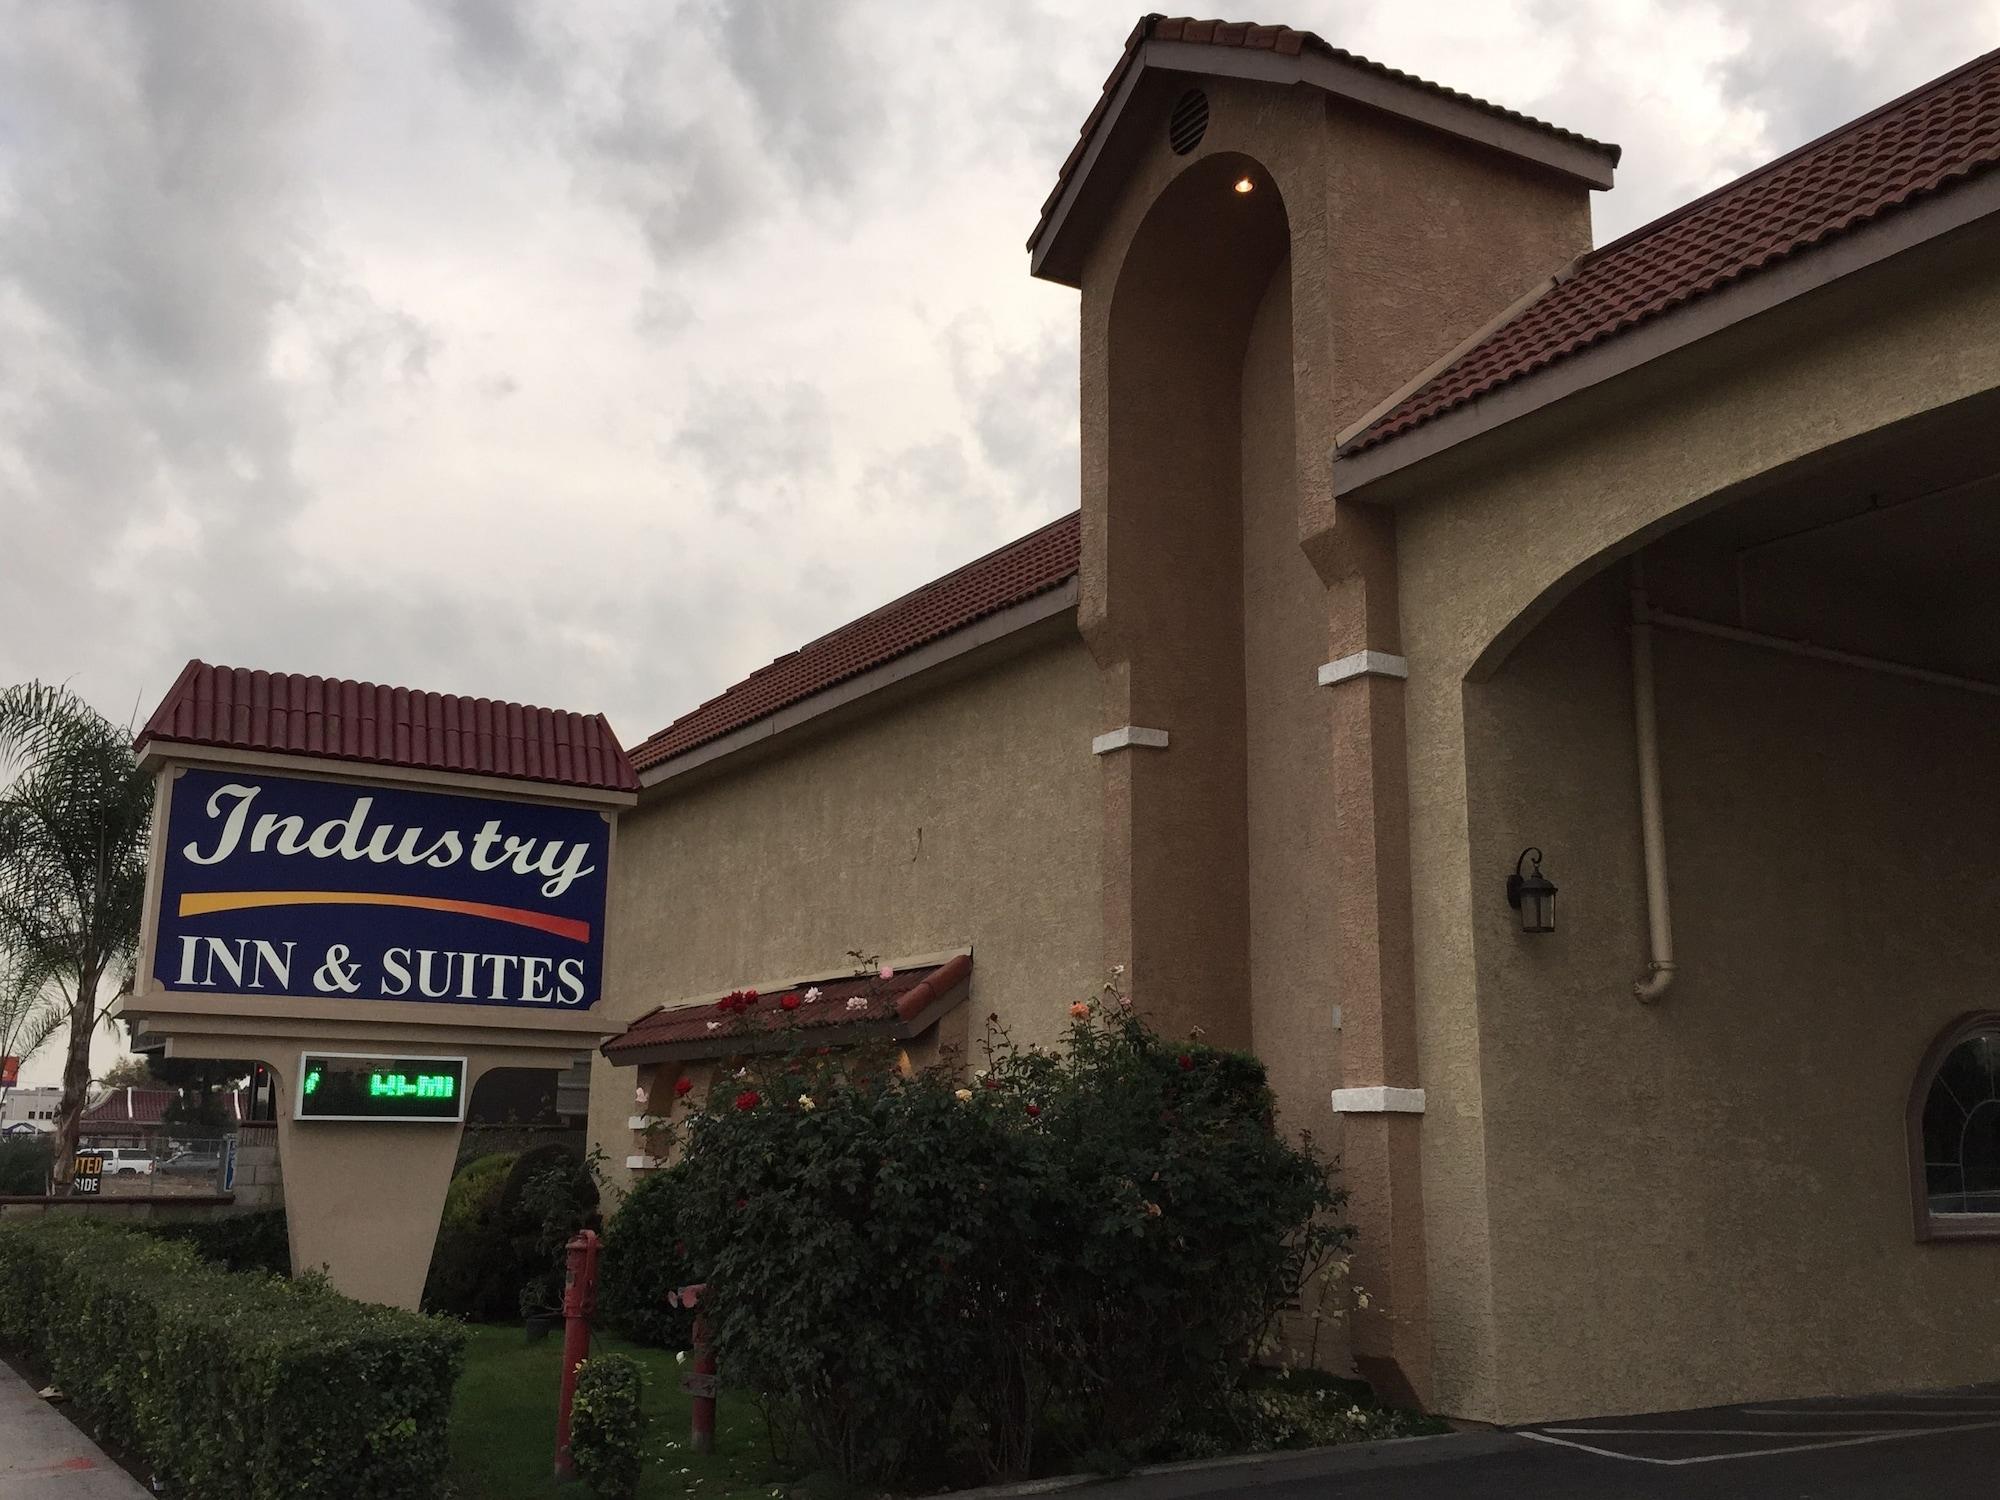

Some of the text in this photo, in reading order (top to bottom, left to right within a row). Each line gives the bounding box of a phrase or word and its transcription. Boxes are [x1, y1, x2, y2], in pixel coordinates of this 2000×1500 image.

[183, 783, 595, 897] Industry
[174, 936, 585, 1004] INN & SUITES
